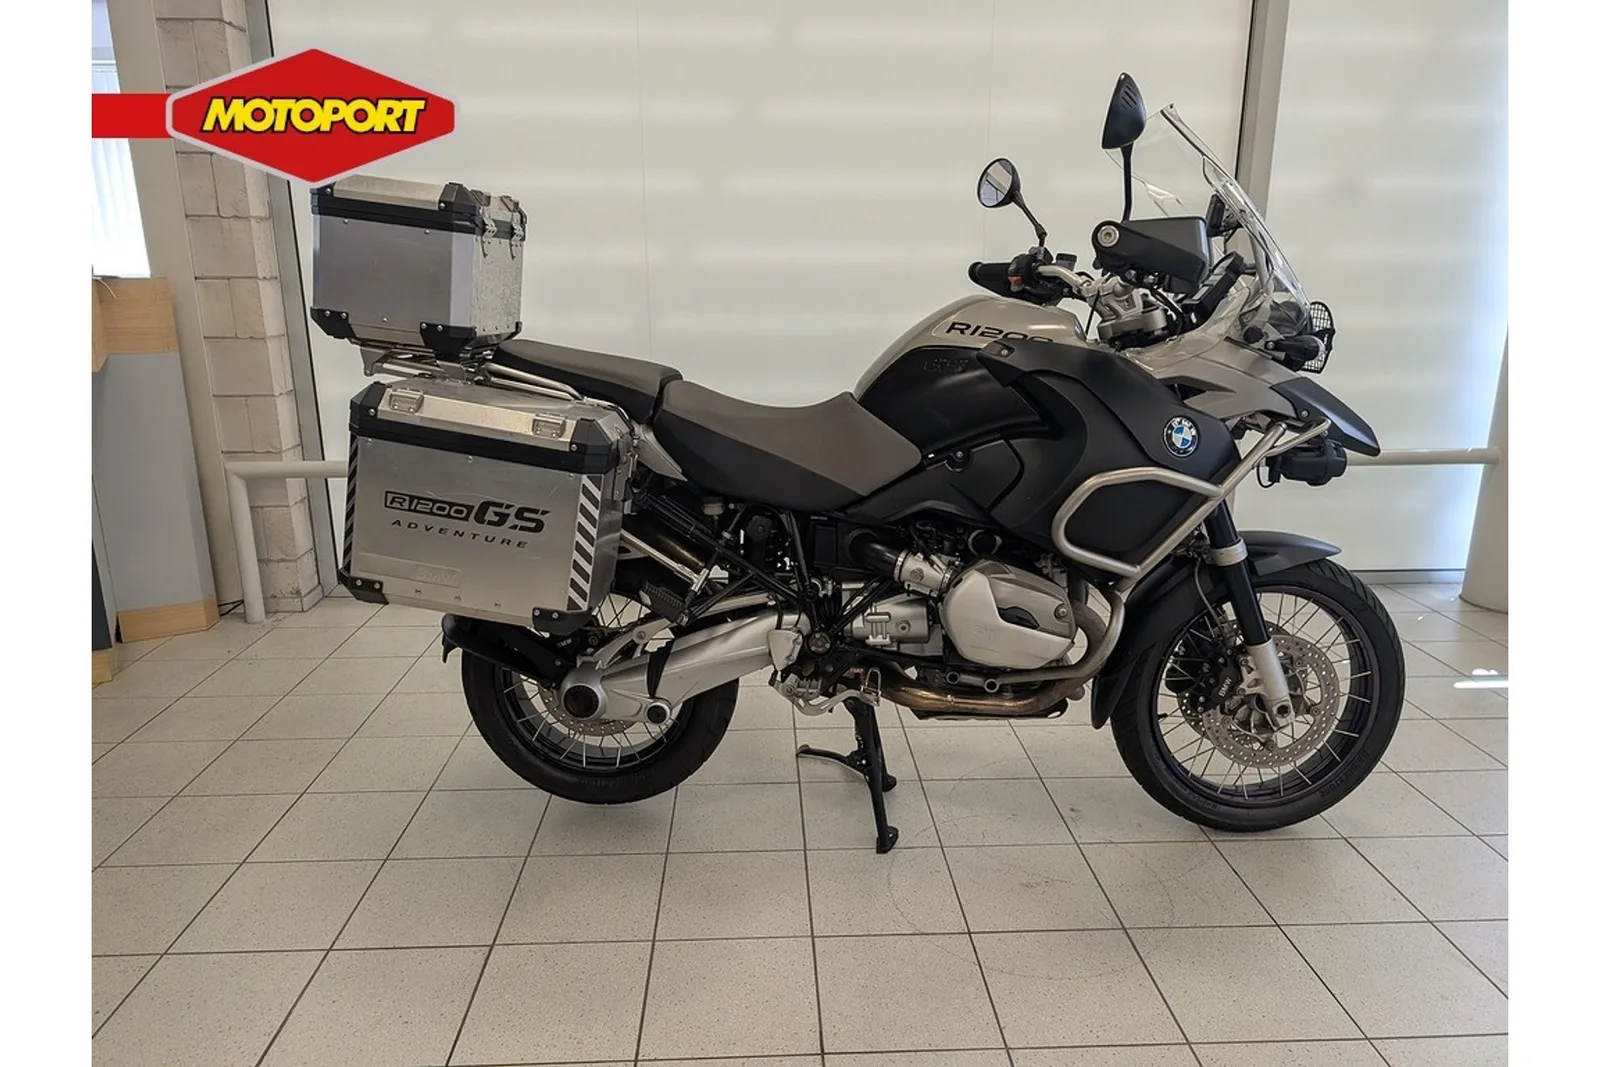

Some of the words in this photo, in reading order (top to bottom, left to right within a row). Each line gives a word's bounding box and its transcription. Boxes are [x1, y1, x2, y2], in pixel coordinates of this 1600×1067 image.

[1171, 417, 1197, 436] BMW
[391, 519, 528, 549] ADVENTURE
[1218, 676, 1233, 698] BMW
